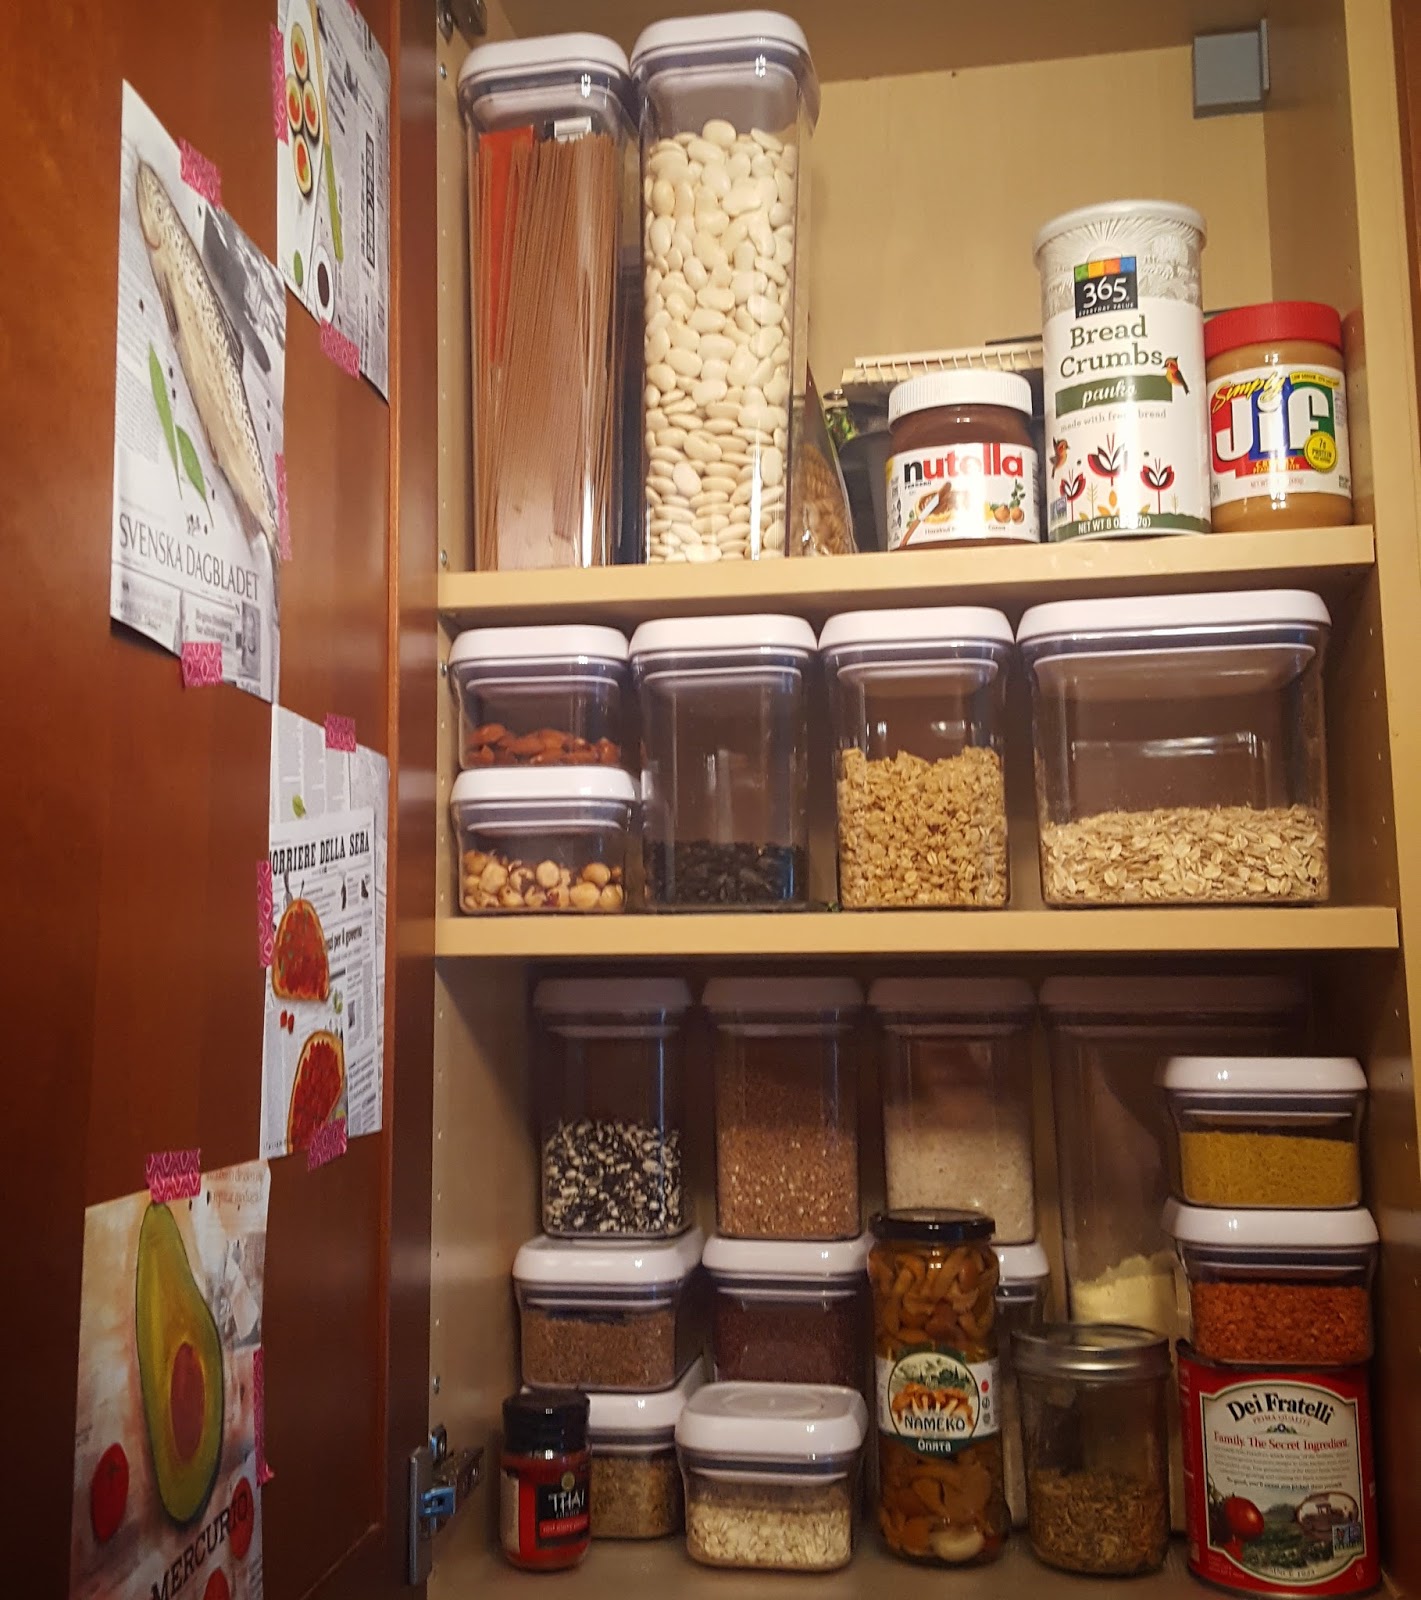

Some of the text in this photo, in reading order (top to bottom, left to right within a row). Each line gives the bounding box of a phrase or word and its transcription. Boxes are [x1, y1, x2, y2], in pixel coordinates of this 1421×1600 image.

[1083, 276, 1127, 308] 365
[1113, 302, 1134, 311] VALUE
[1070, 314, 1148, 350] Bread
[1060, 343, 1163, 378] Crumbs
[1213, 371, 1286, 413] Simply
[1060, 420, 1082, 432] made
[1083, 412, 1105, 425] with
[1138, 408, 1167, 419] bread
[904, 443, 1024, 483] nutella
[1078, 521, 1091, 534] NET
[1092, 519, 1105, 532] WT
[119, 513, 260, 601] SVENSKA DAGBLADET
[320, 836, 346, 865] DELLA
[349, 830, 370, 856] SERA
[904, 1414, 966, 1432] NAMEKO
[1226, 1391, 1334, 1426] Dei Fratelli
[1249, 1436, 1265, 1448] The
[1269, 1439, 1300, 1451] Secret
[1304, 1438, 1349, 1453] Ingredient
[547, 1488, 585, 1518] THAI
